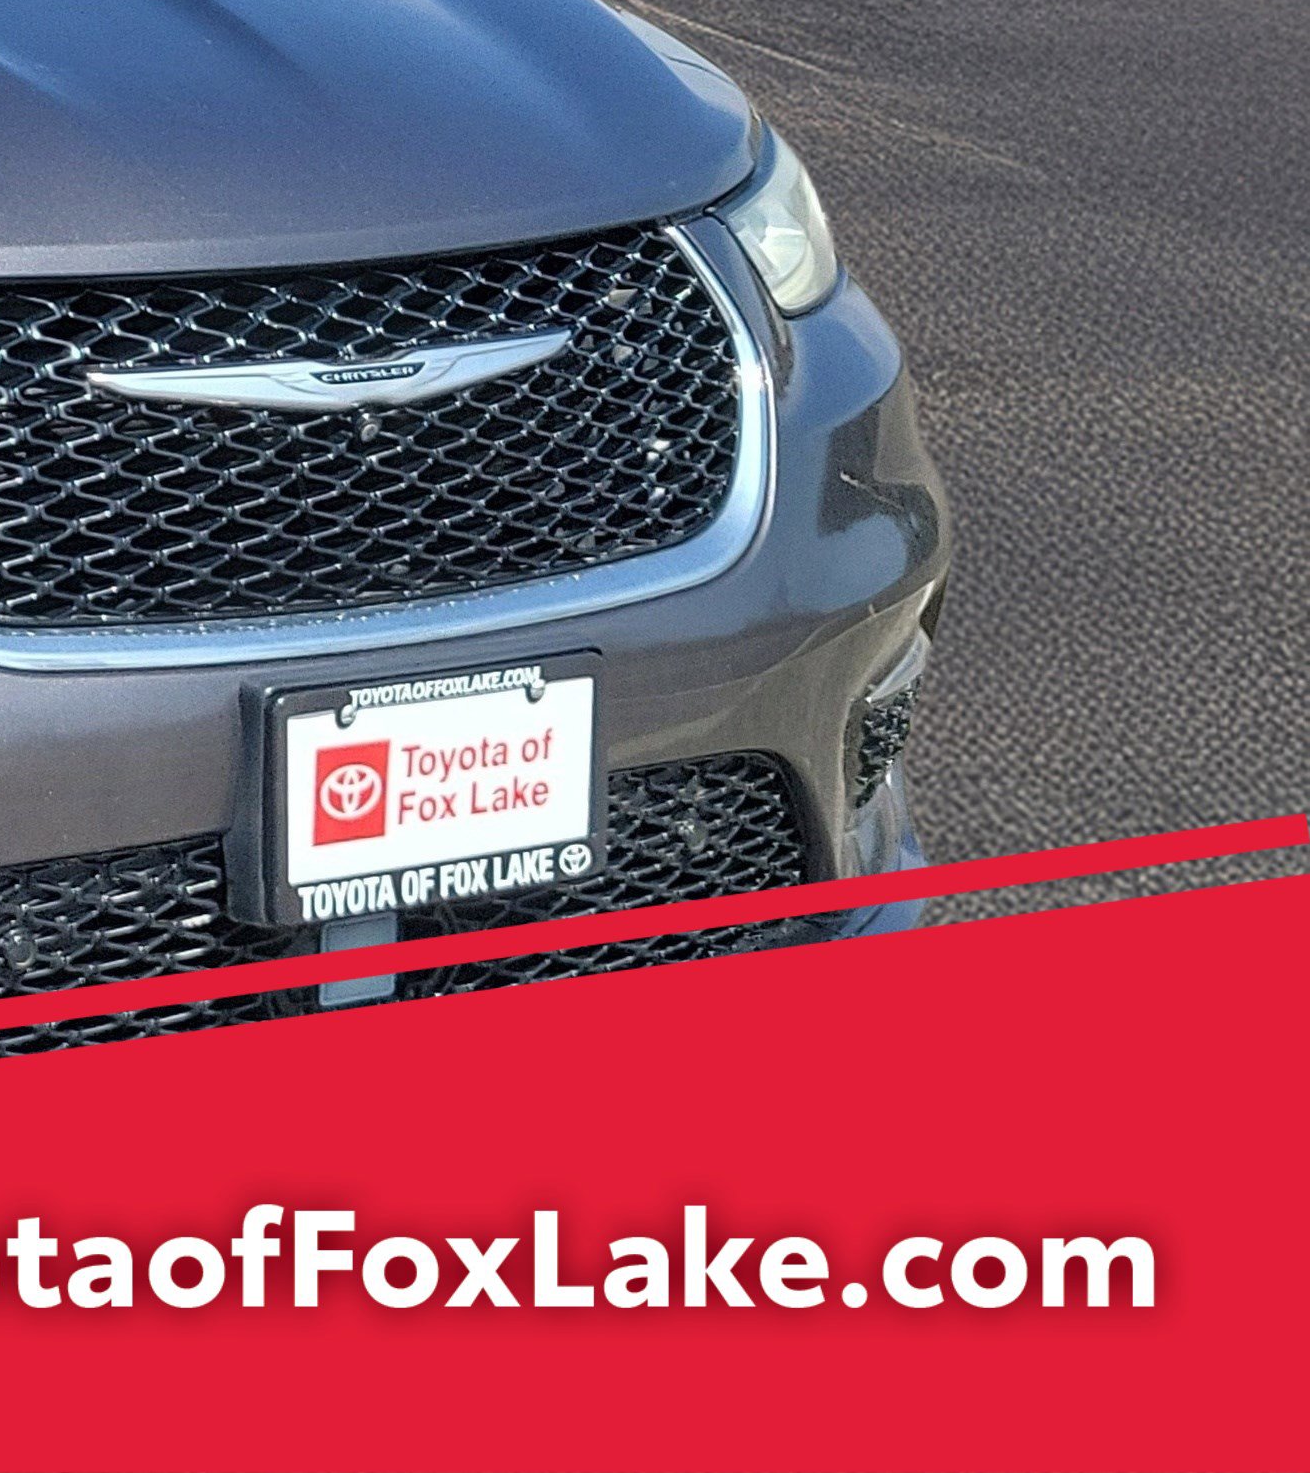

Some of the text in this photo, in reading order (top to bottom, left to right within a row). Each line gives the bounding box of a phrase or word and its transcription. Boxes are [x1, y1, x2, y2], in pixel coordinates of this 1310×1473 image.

[321, 366, 414, 382] CHRYSLER
[349, 666, 542, 707] TOYOTAOFFOXLAKE.COM
[401, 727, 553, 782] Toyota of
[397, 776, 550, 825] Fox Lake
[298, 847, 555, 921] TOYOTA OF FOX LAKE
